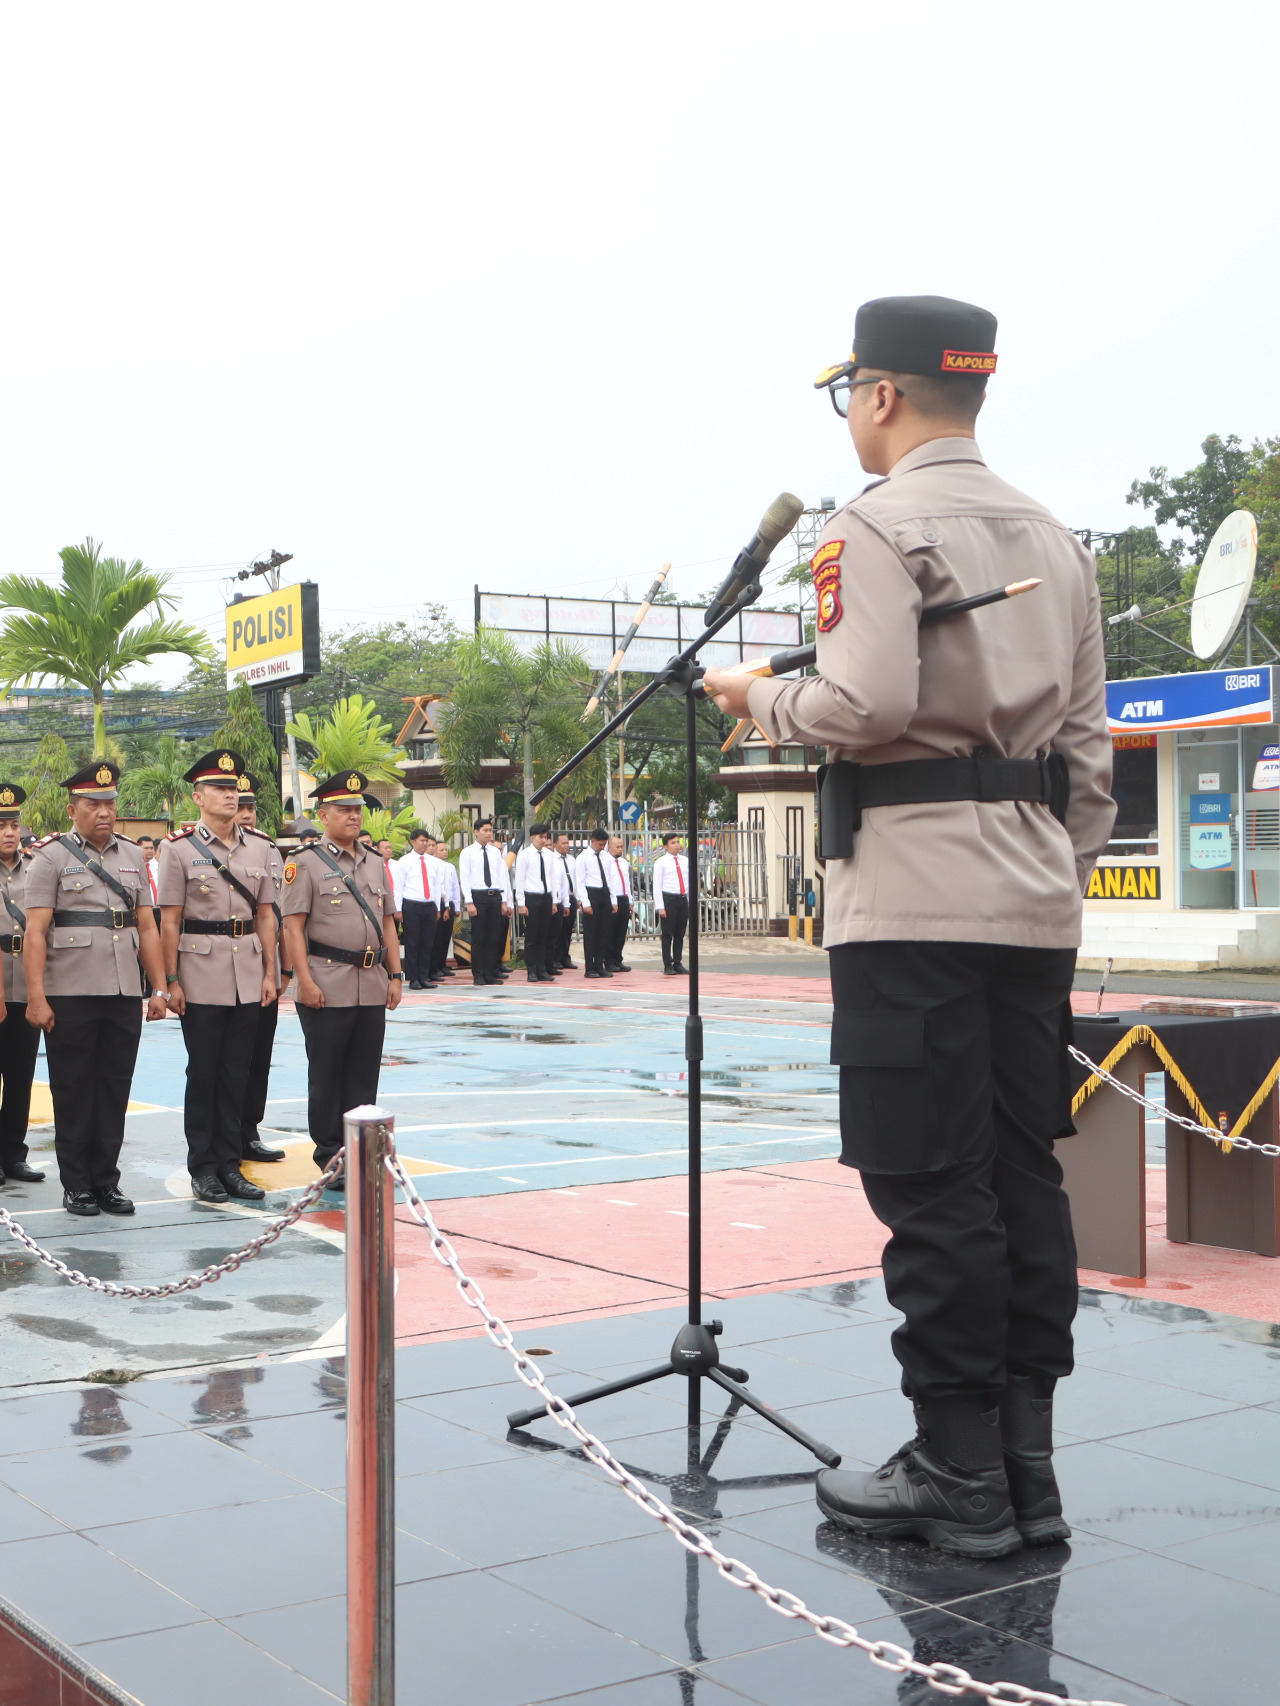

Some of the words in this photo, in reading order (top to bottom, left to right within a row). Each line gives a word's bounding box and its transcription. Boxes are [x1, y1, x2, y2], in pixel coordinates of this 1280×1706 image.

[946, 355, 995, 369] KAPOLRES
[1220, 542, 1233, 557] BRI
[233, 604, 292, 651] POLISI
[235, 666, 266, 681] OLRES
[268, 660, 290, 676] INHIL
[1239, 674, 1260, 689] BRI
[1120, 700, 1163, 719] ATM
[1208, 803, 1221, 813] BRI
[1199, 832, 1222, 840] ATM
